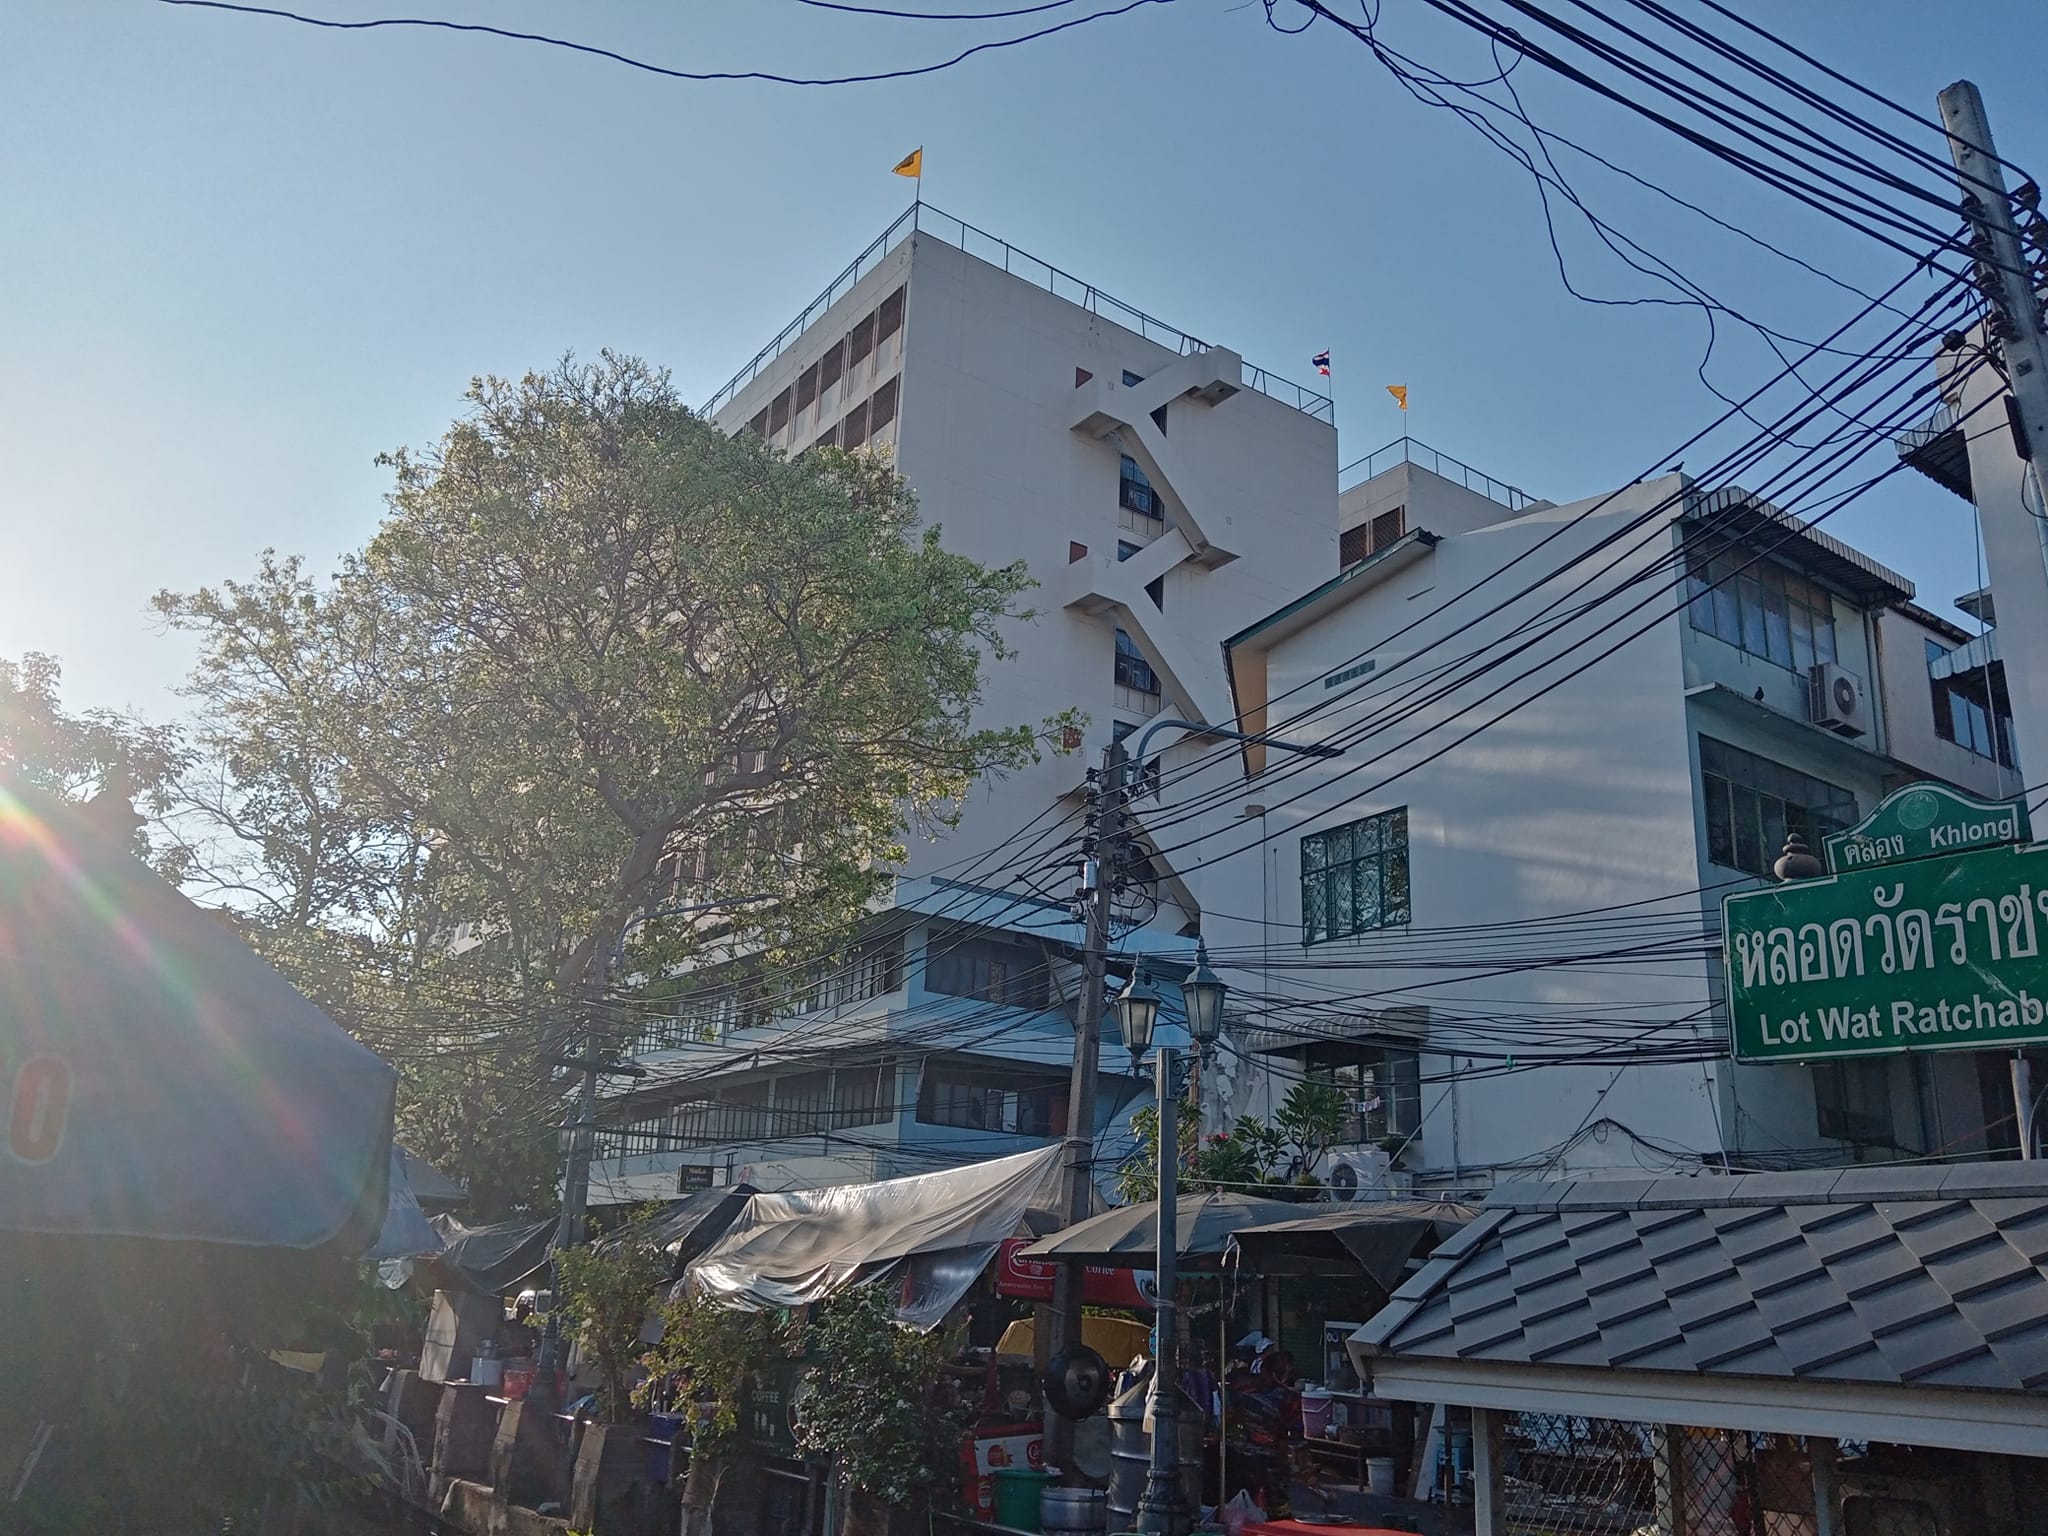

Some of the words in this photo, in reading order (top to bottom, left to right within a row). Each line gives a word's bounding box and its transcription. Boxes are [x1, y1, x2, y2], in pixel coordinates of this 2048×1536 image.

[1843, 834, 1905, 866] คลอง
[1930, 817, 2014, 848] Khlong
[1735, 883, 2048, 988] หลอดวัดราช
[1760, 1013, 1812, 1045] Lot
[1818, 1006, 1882, 1041] Wat
[1891, 990, 2048, 1035] Ratchab
